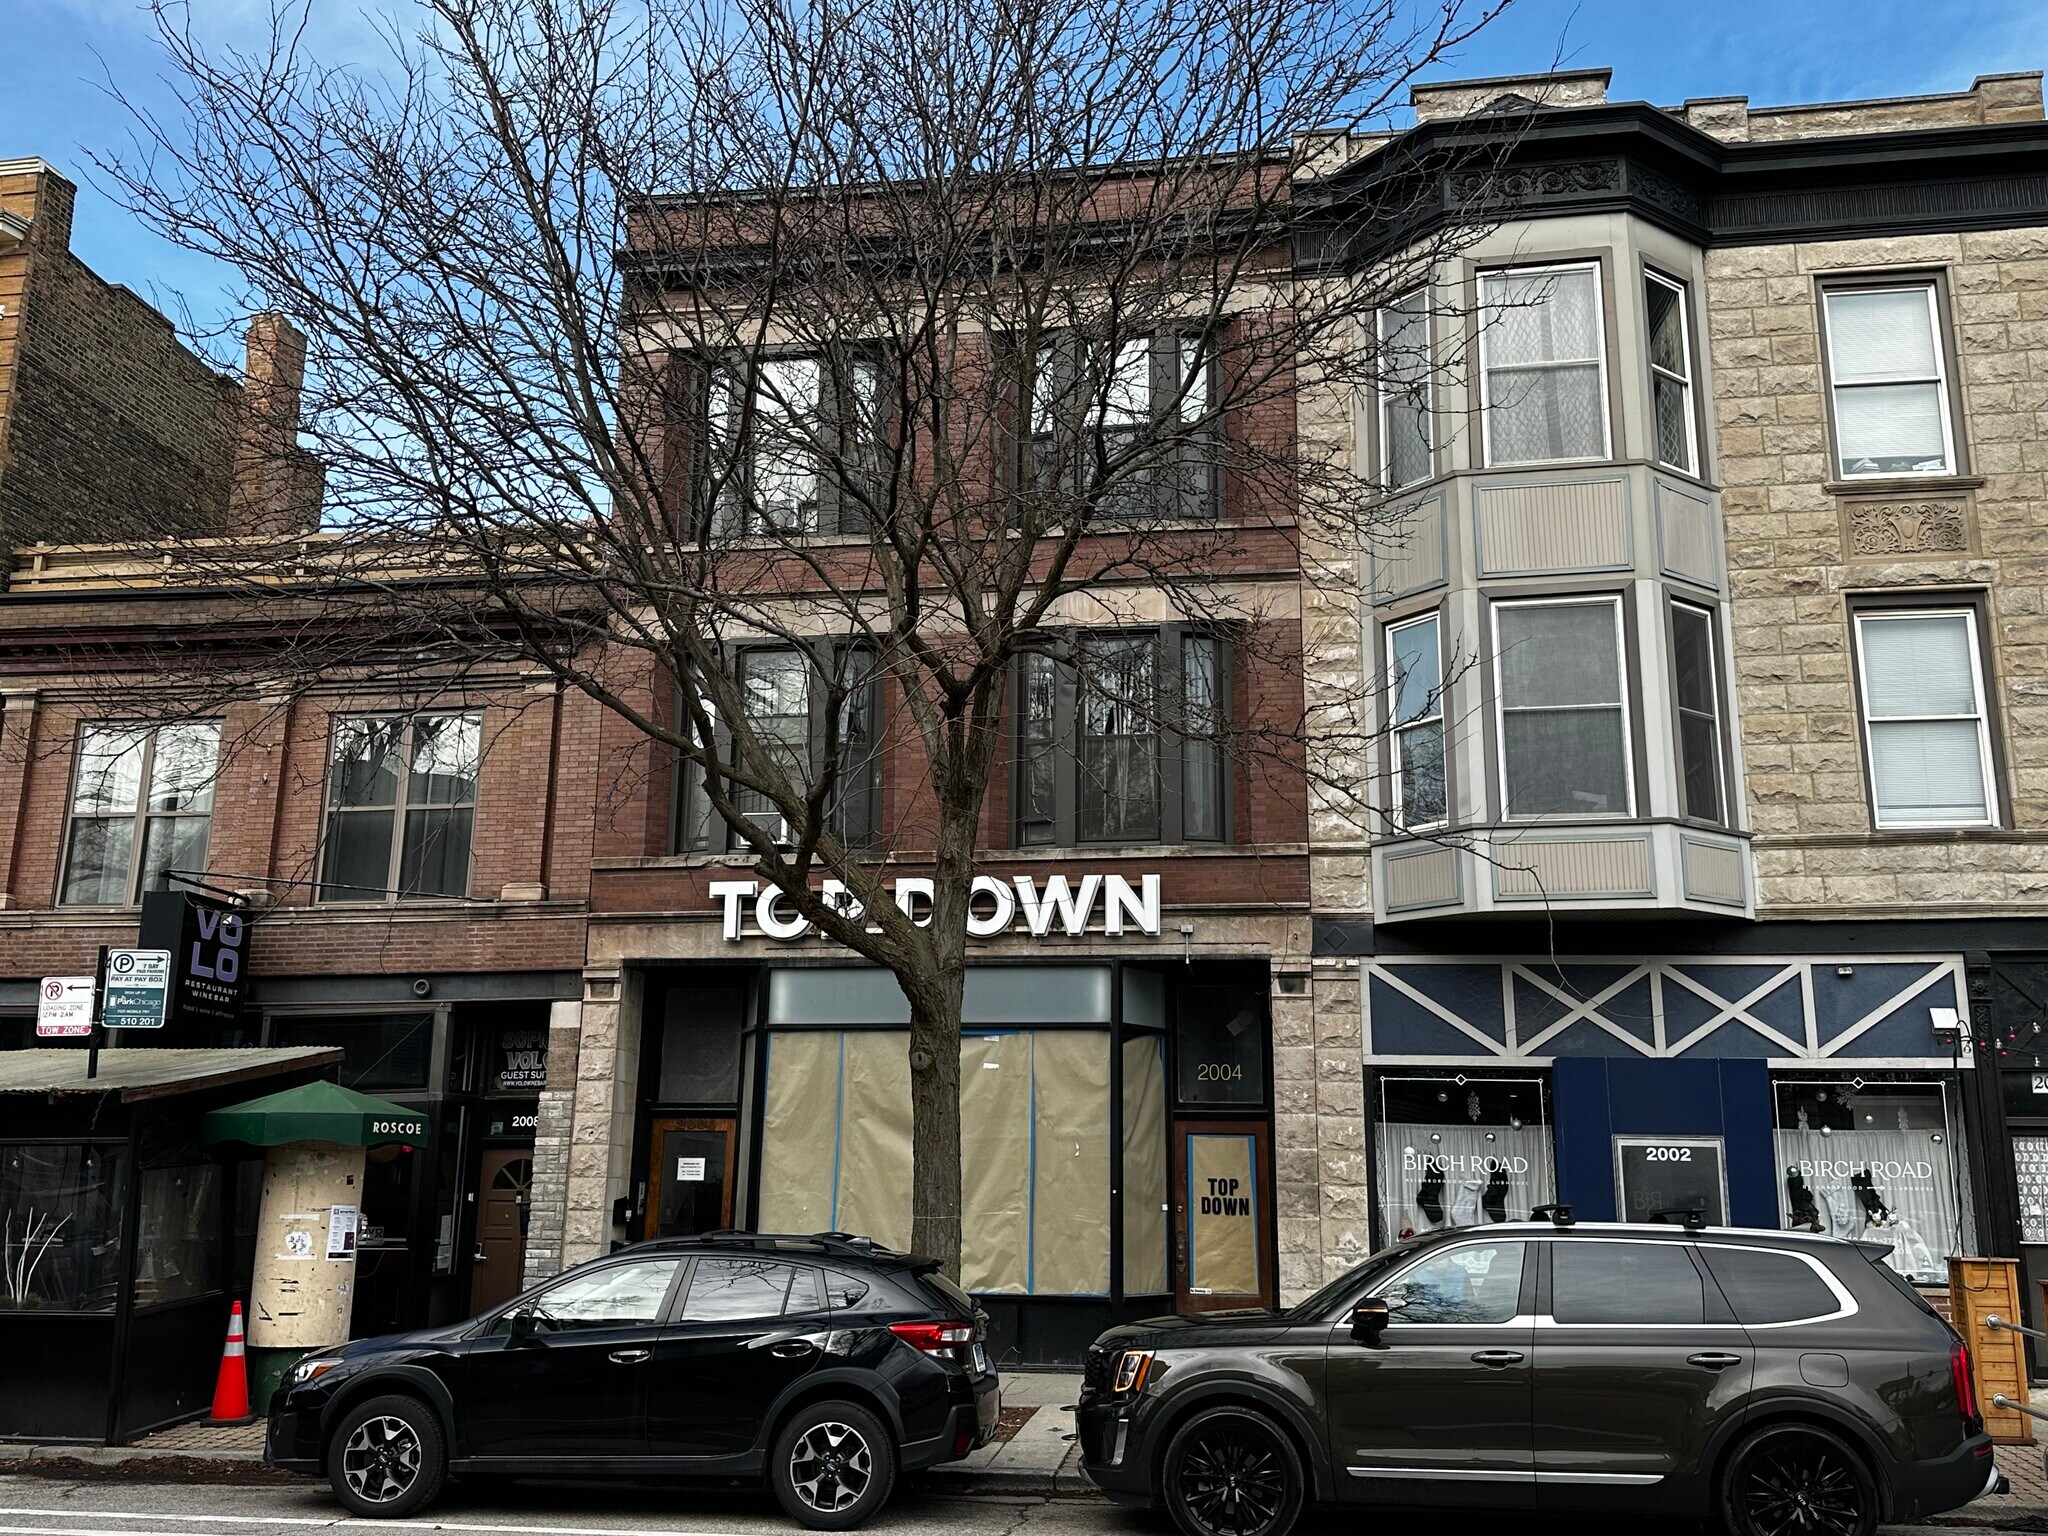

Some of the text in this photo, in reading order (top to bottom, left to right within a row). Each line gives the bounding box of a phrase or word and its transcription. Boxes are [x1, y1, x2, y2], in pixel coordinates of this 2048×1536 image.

[184, 979, 239, 997] RESTAURANT
[117, 996, 161, 1007] ParkChicago
[192, 989, 230, 1004] WINEBAR
[41, 1026, 85, 1034] TOW ZONE
[500, 1071, 530, 1080] GUEST
[1197, 1063, 1243, 1081] 2004
[373, 1122, 422, 1134] ROSCOE
[1646, 1148, 1691, 1162] 2002
[1404, 1154, 1528, 1174] BIRCH ROAD
[1800, 1160, 1932, 1180] BIRCH ROAD
[1208, 1178, 1238, 1196] TOP
[1201, 1196, 1249, 1216] DOWN
